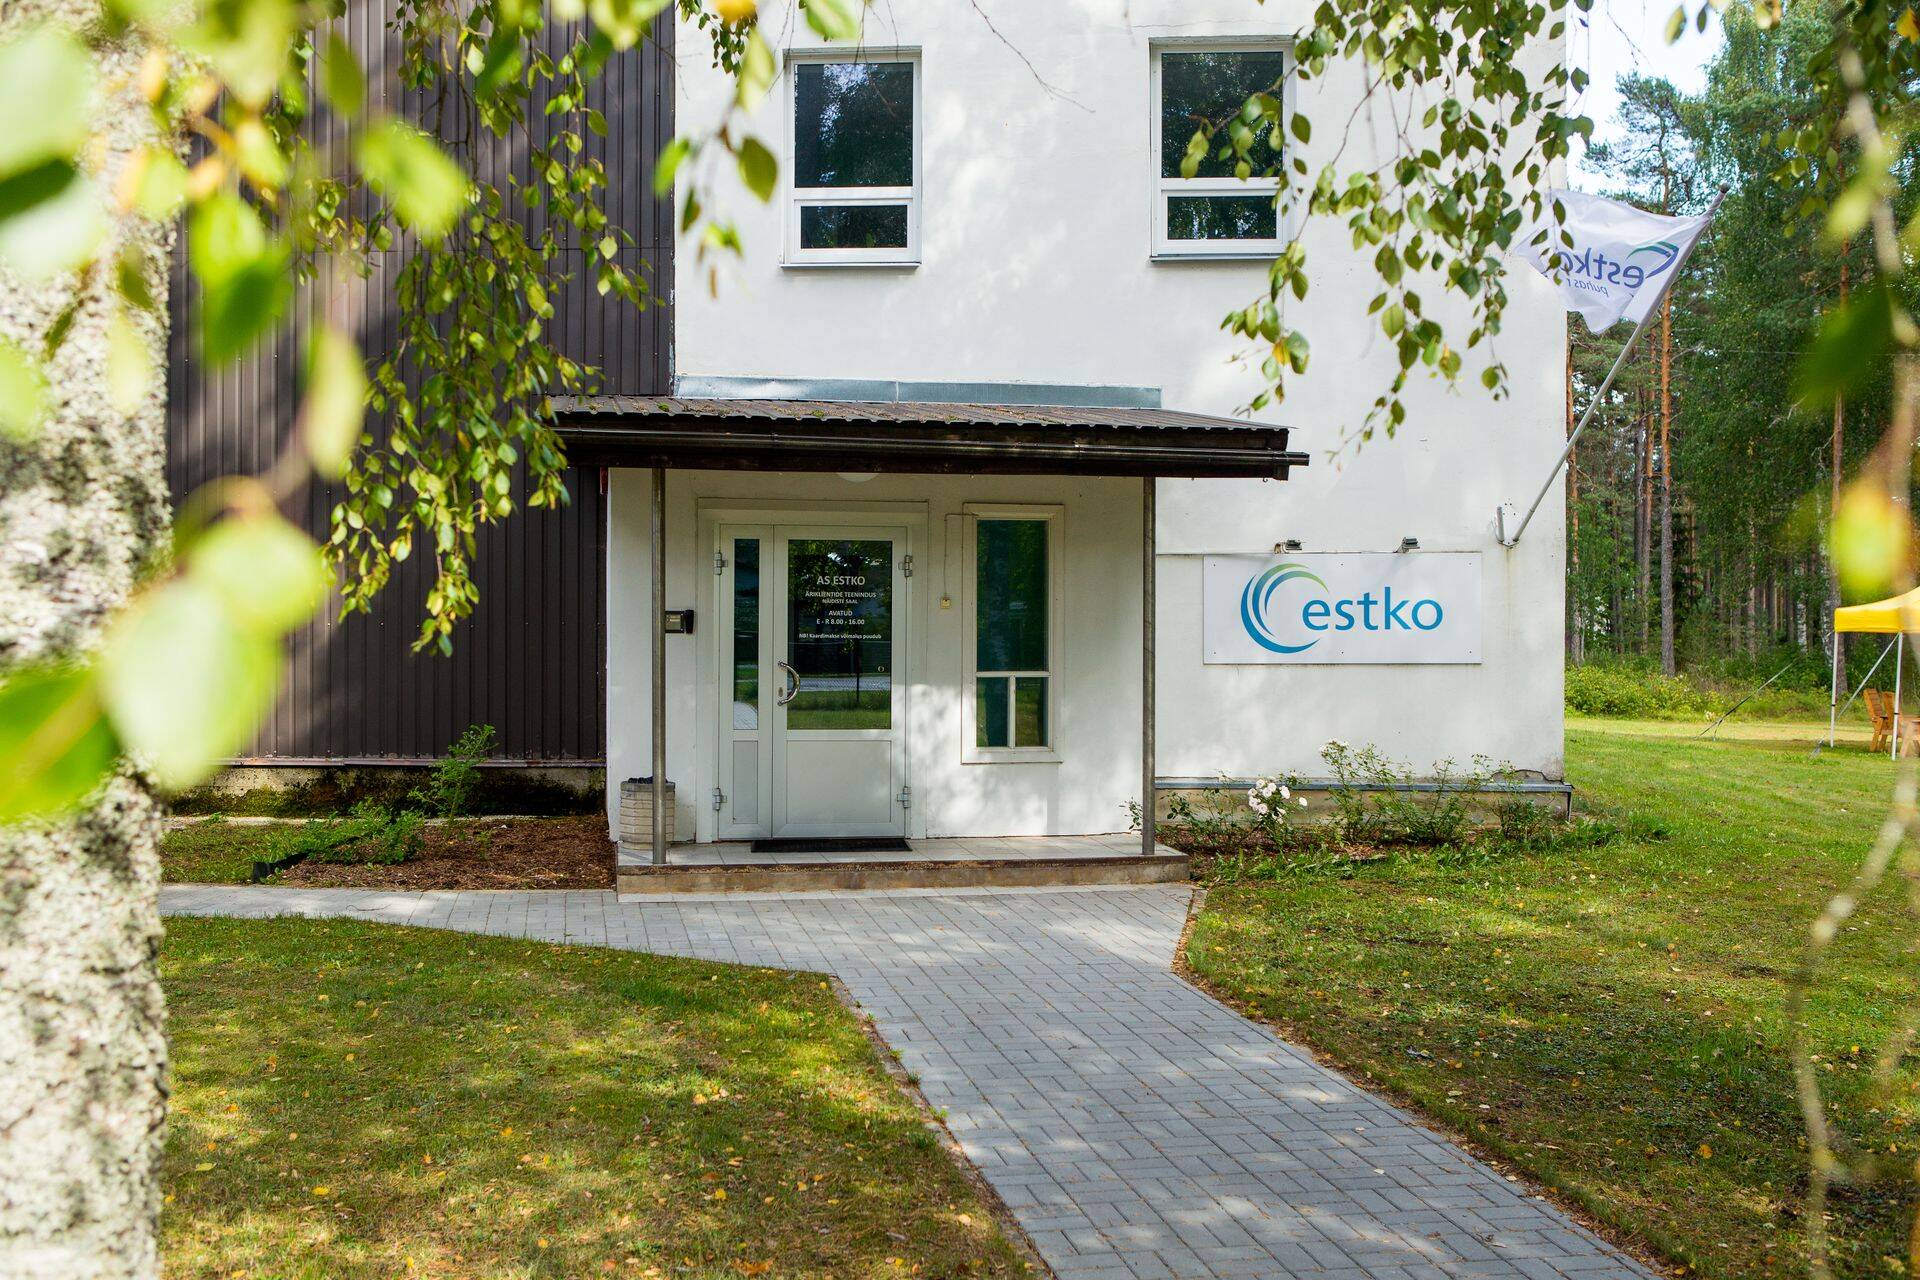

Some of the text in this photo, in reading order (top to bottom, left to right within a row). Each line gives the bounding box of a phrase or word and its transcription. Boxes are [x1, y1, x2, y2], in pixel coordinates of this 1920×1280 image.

[816, 576, 866, 585] AS ESTKO
[1301, 586, 1444, 631] estko
